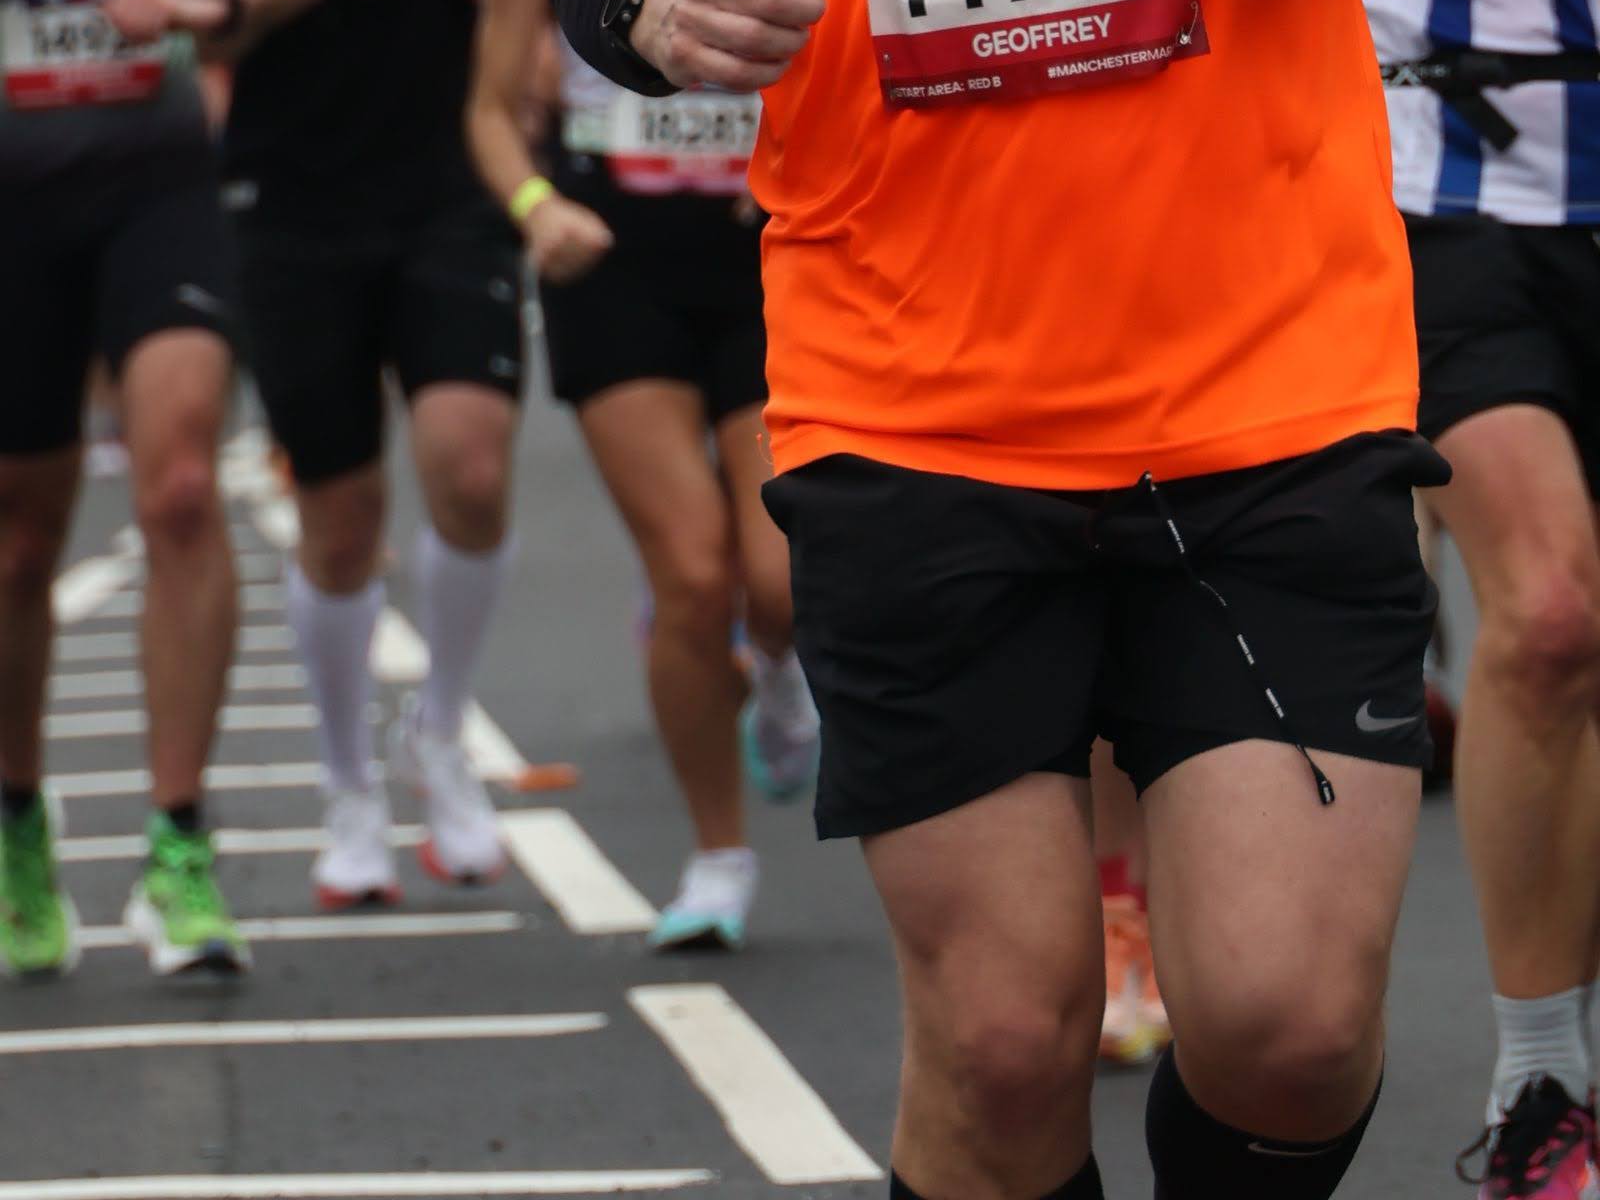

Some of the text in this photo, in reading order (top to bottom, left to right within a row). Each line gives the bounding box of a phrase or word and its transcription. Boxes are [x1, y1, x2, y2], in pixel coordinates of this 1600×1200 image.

[972, 13, 1112, 58] GEOFFREY
[896, 76, 1002, 98] START AREA: RED B
